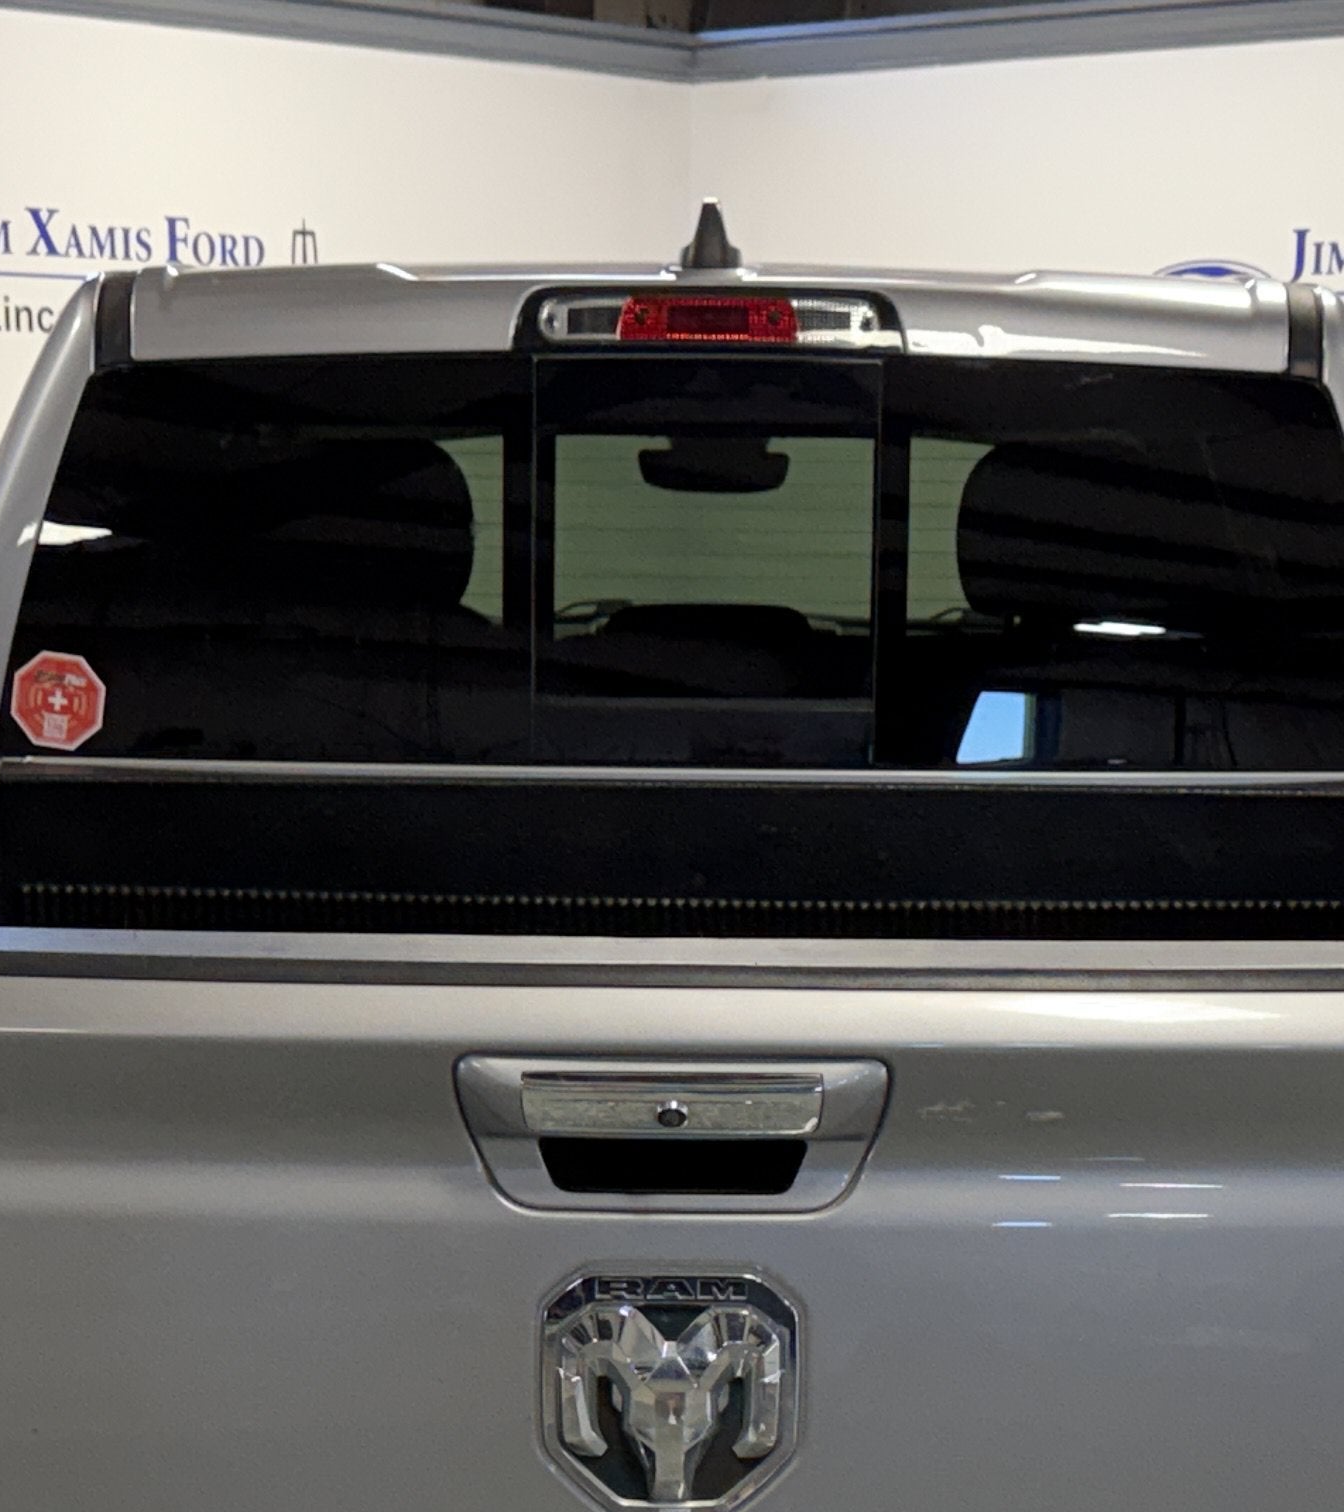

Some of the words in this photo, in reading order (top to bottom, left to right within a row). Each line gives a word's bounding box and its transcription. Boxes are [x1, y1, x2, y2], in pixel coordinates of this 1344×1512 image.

[25, 207, 152, 263] XAMIS
[163, 216, 266, 268] FORD
[594, 1277, 749, 1301] RAM
